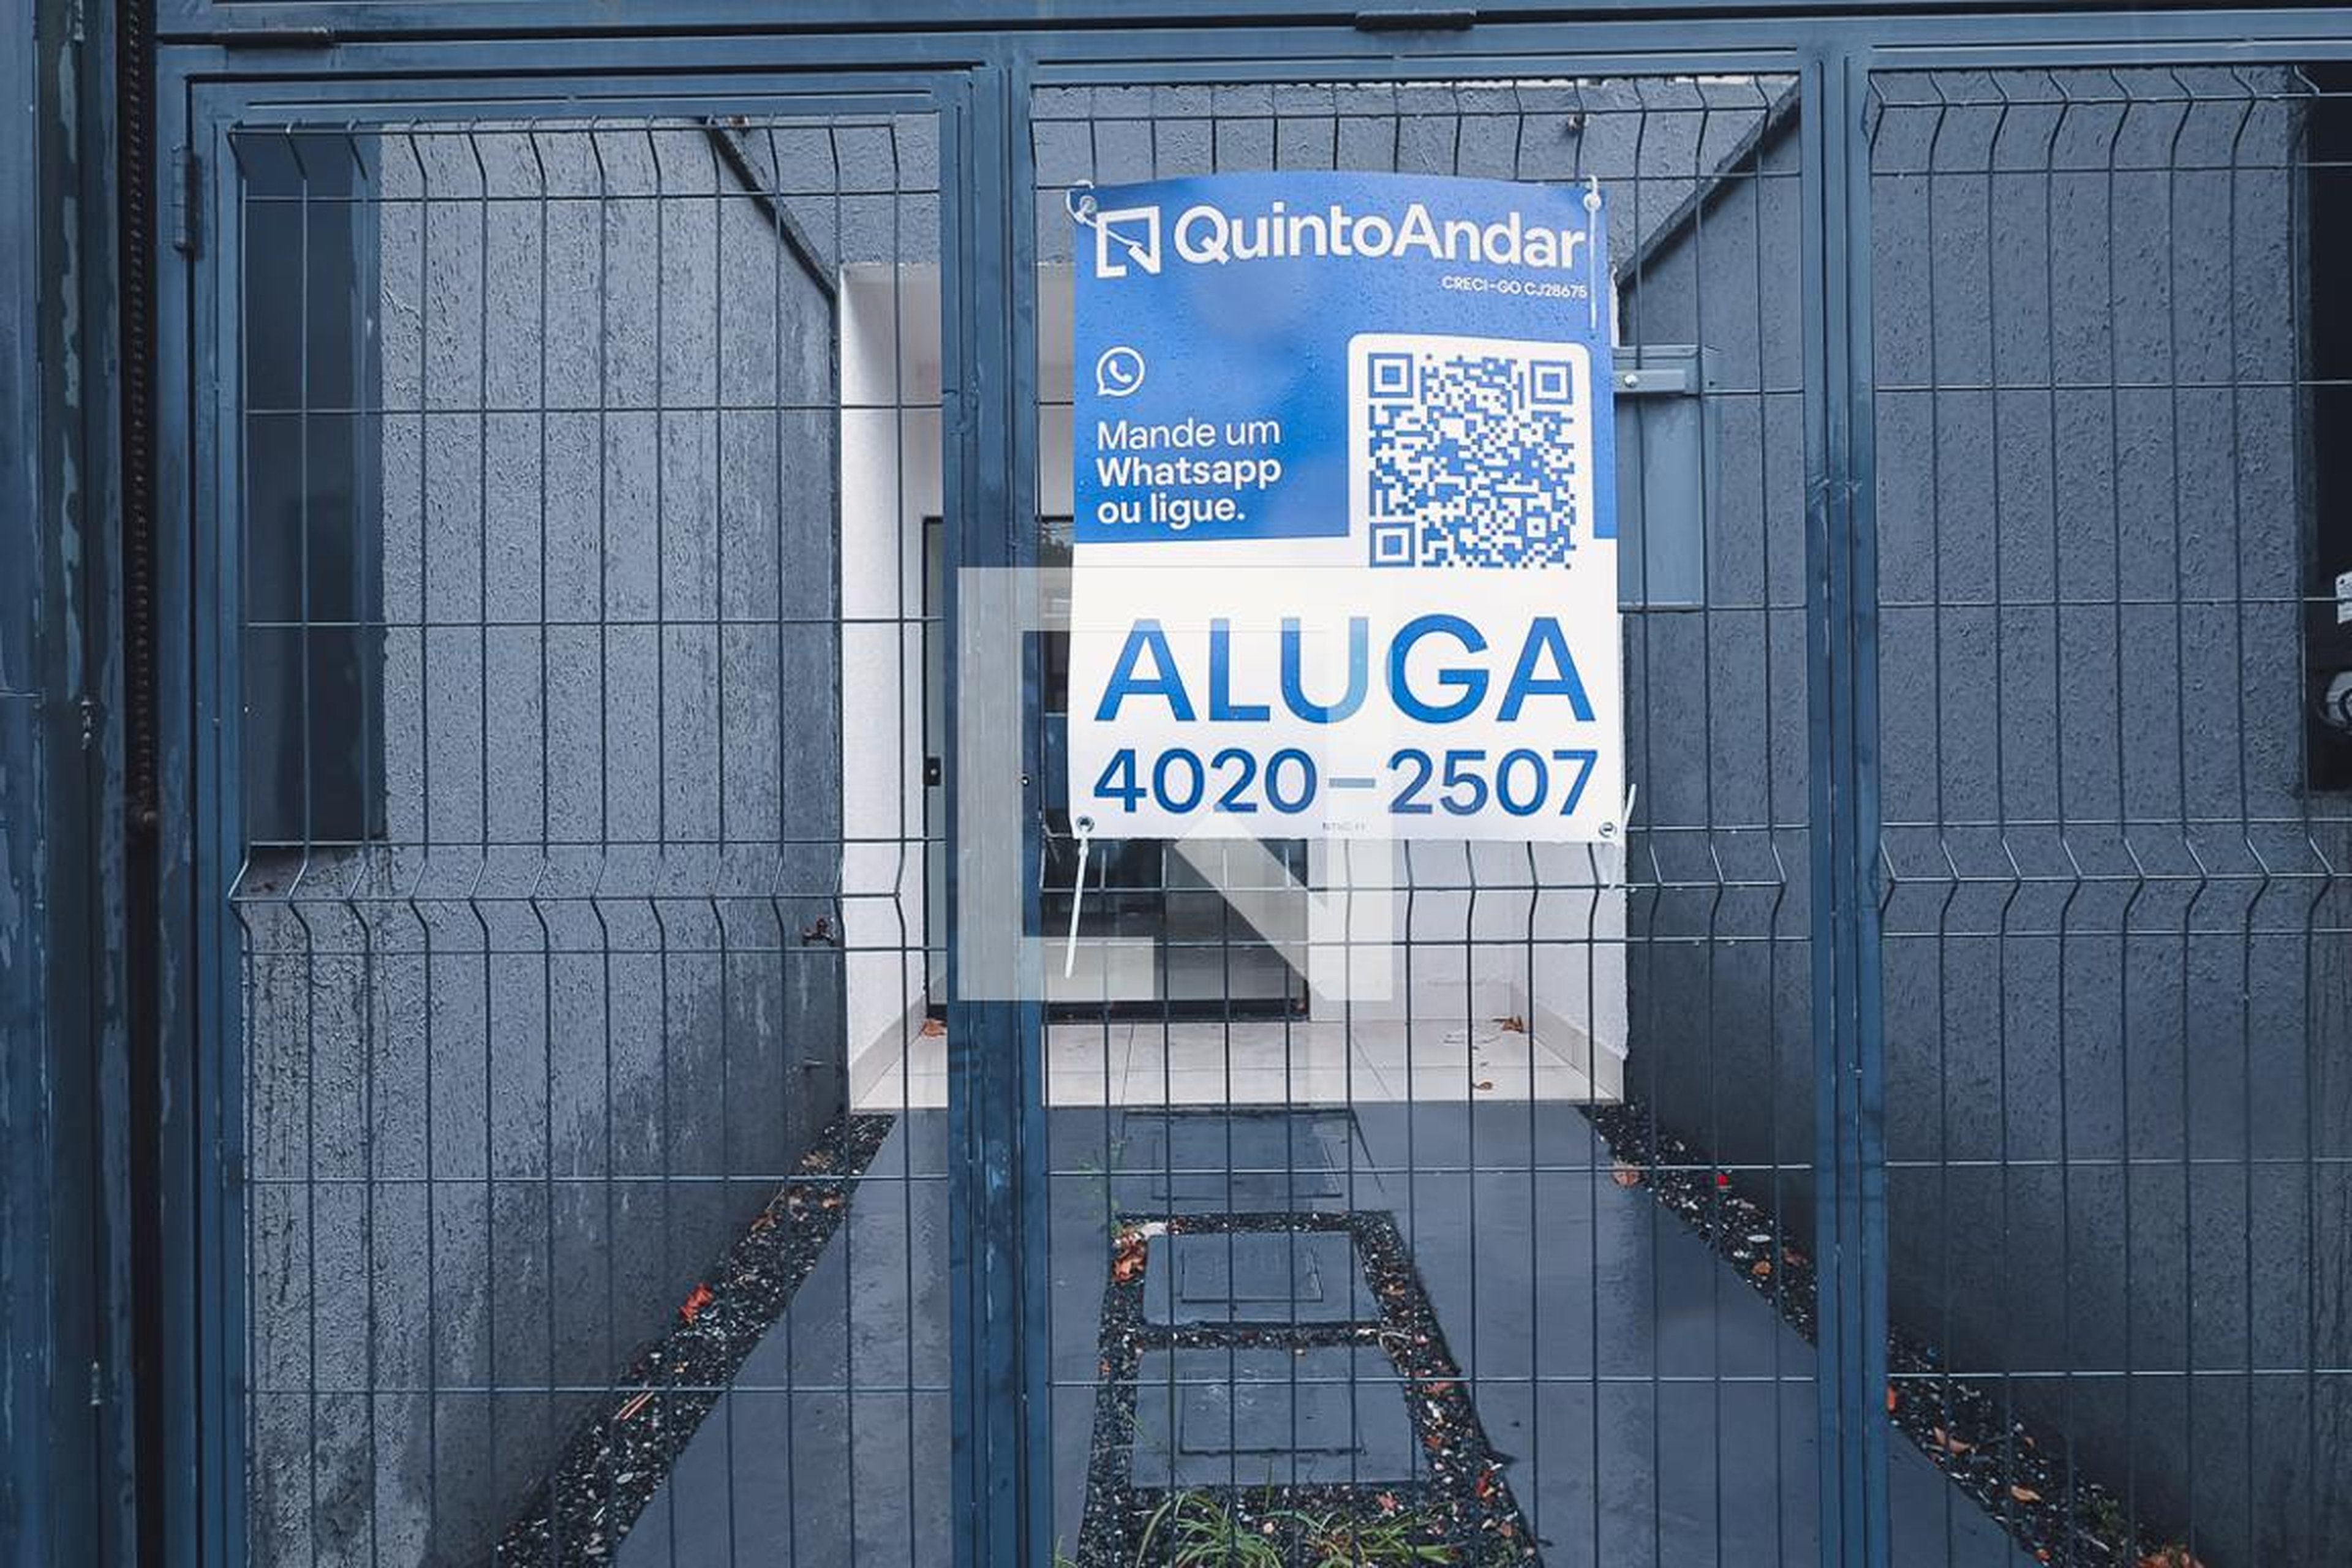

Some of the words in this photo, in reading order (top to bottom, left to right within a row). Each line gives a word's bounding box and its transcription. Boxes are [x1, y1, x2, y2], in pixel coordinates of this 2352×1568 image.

[1174, 201, 1586, 269] QuintoAndar
[1441, 274, 1522, 295] CRECI-GO
[1097, 418, 1216, 450] Mande
[1226, 420, 1281, 446] um
[1097, 456, 1281, 489] Whatsapp
[1097, 502, 1141, 524] ou
[1150, 492, 1246, 530] ligue.
[1093, 613, 1597, 725] ALUGA
[1093, 747, 1599, 816] 4020-2507
